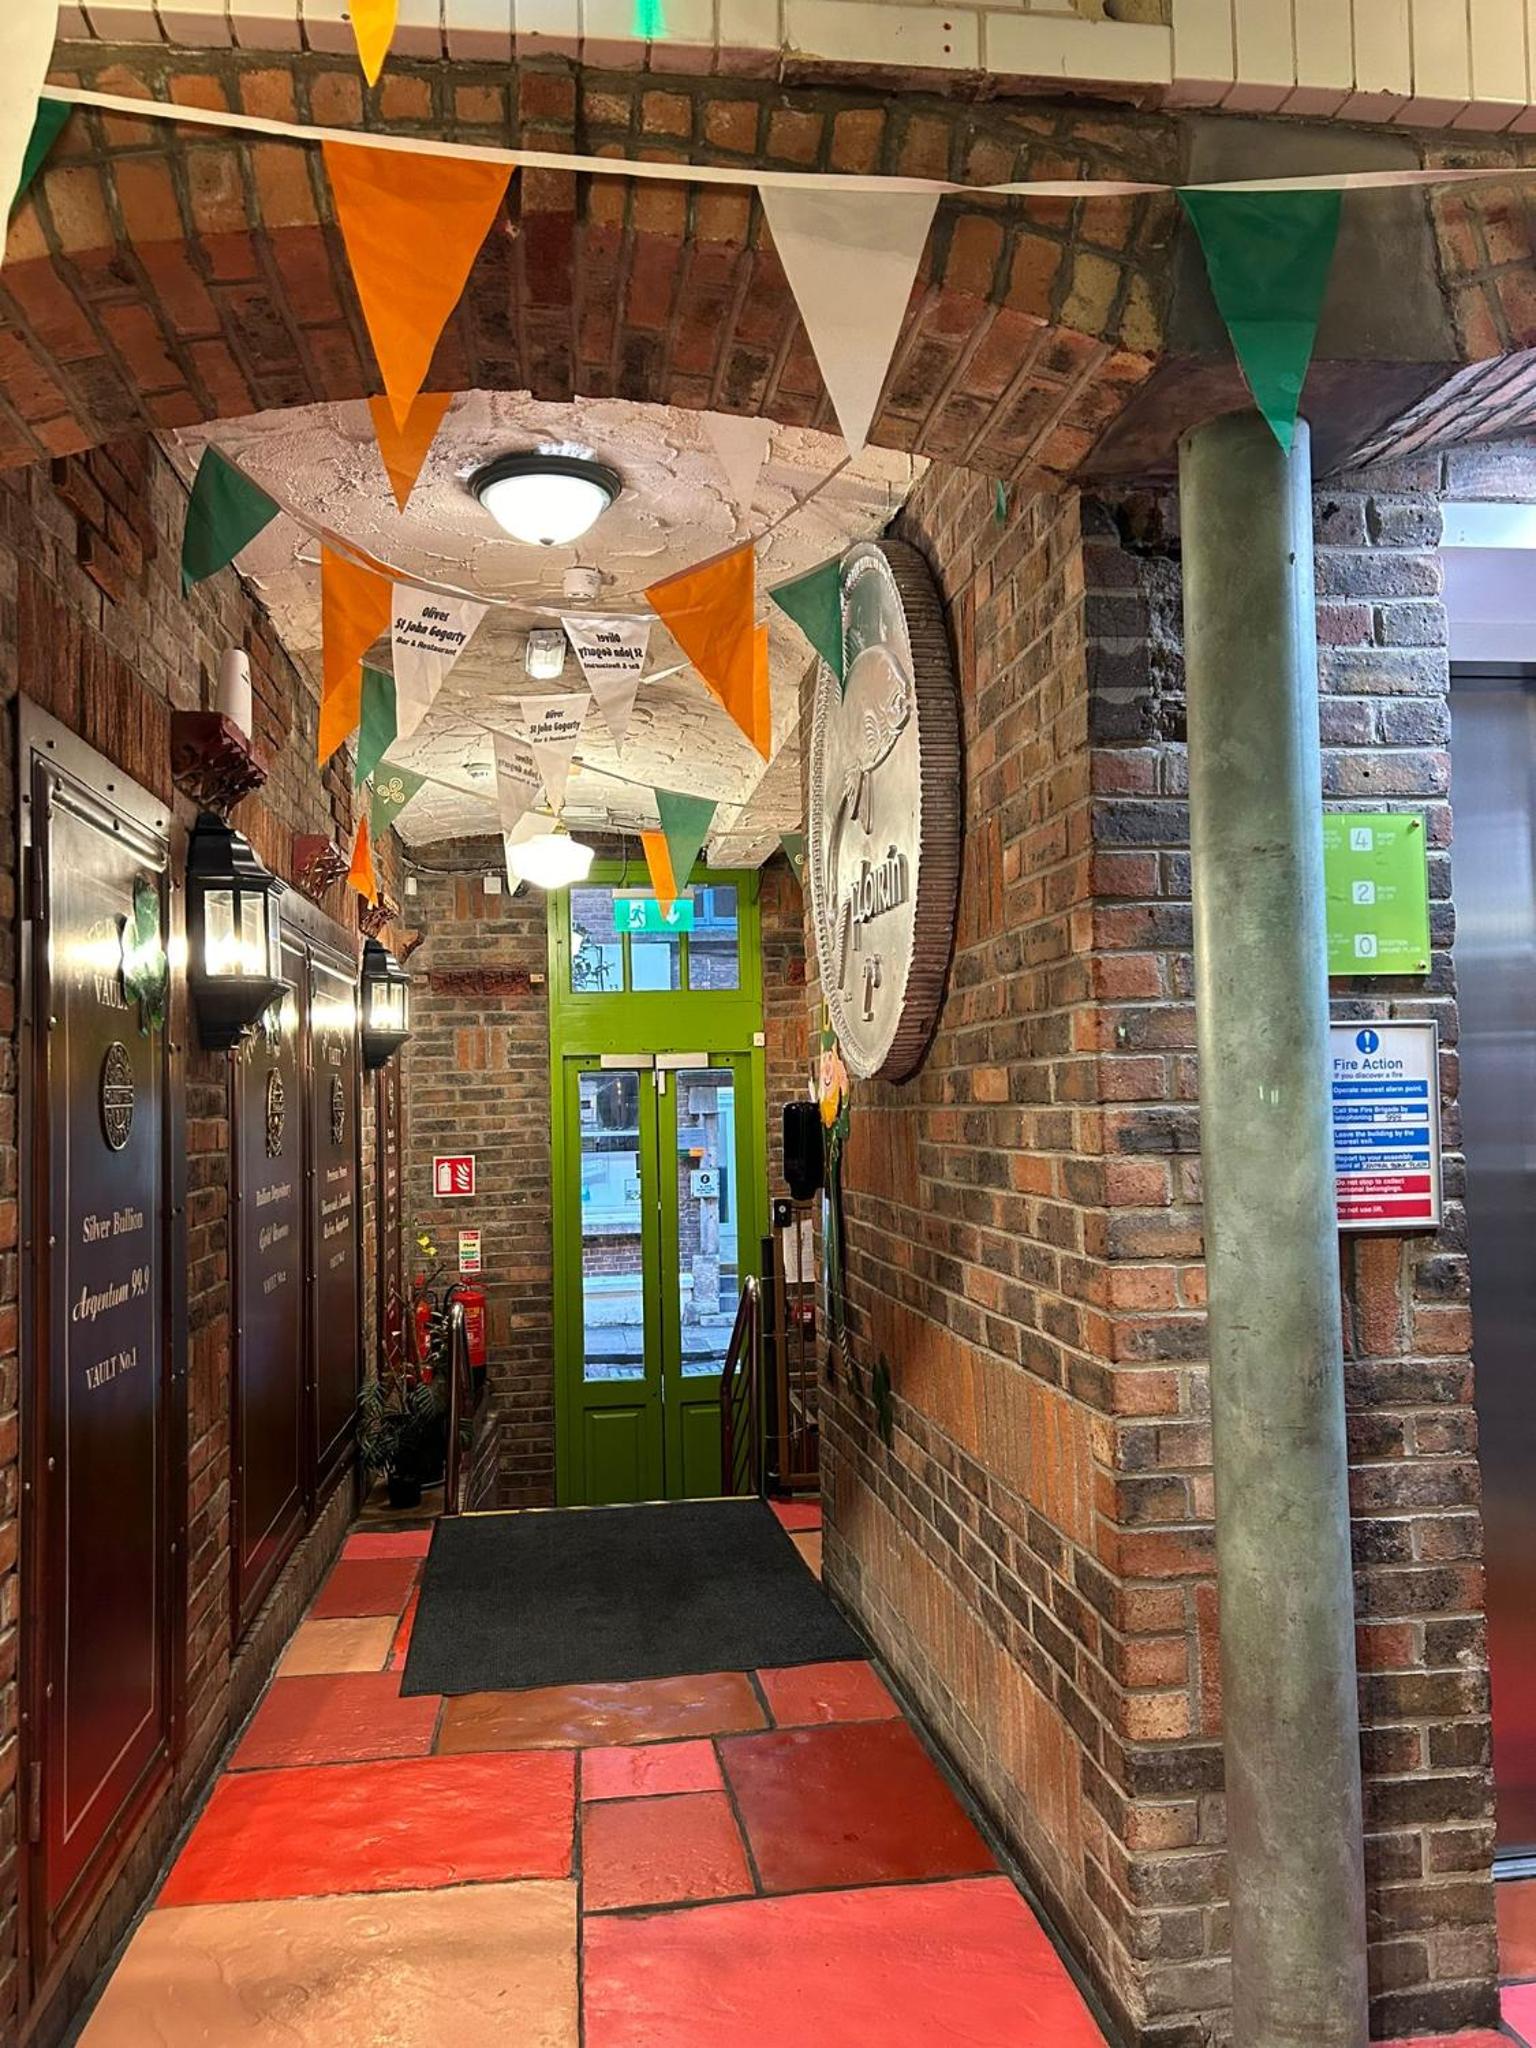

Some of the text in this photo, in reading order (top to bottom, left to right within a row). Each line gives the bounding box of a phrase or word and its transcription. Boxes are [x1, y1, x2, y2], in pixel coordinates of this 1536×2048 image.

[422, 606, 450, 622] Oliver
[394, 617, 467, 646] St John Gogarty
[396, 636, 457, 656] Bar & Restaurant
[545, 709, 565, 719] Oliver
[530, 721, 581, 735] St John Gogarty
[1355, 830, 1369, 848] 4
[1358, 883, 1370, 902] 2
[1360, 936, 1373, 955] 0
[93, 974, 129, 1011] VAUL
[1333, 1058, 1403, 1070] Fire Action
[1385, 1085, 1404, 1093] alarm
[1374, 1106, 1399, 1115] Brigade
[1400, 1105, 1409, 1114] by
[1367, 1130, 1393, 1139] building
[1394, 1130, 1403, 1139] by
[83, 1206, 144, 1243] Silver Bullion
[72, 1264, 151, 1322] Argentum 99.9
[85, 1346, 138, 1390] VAULT No.1
